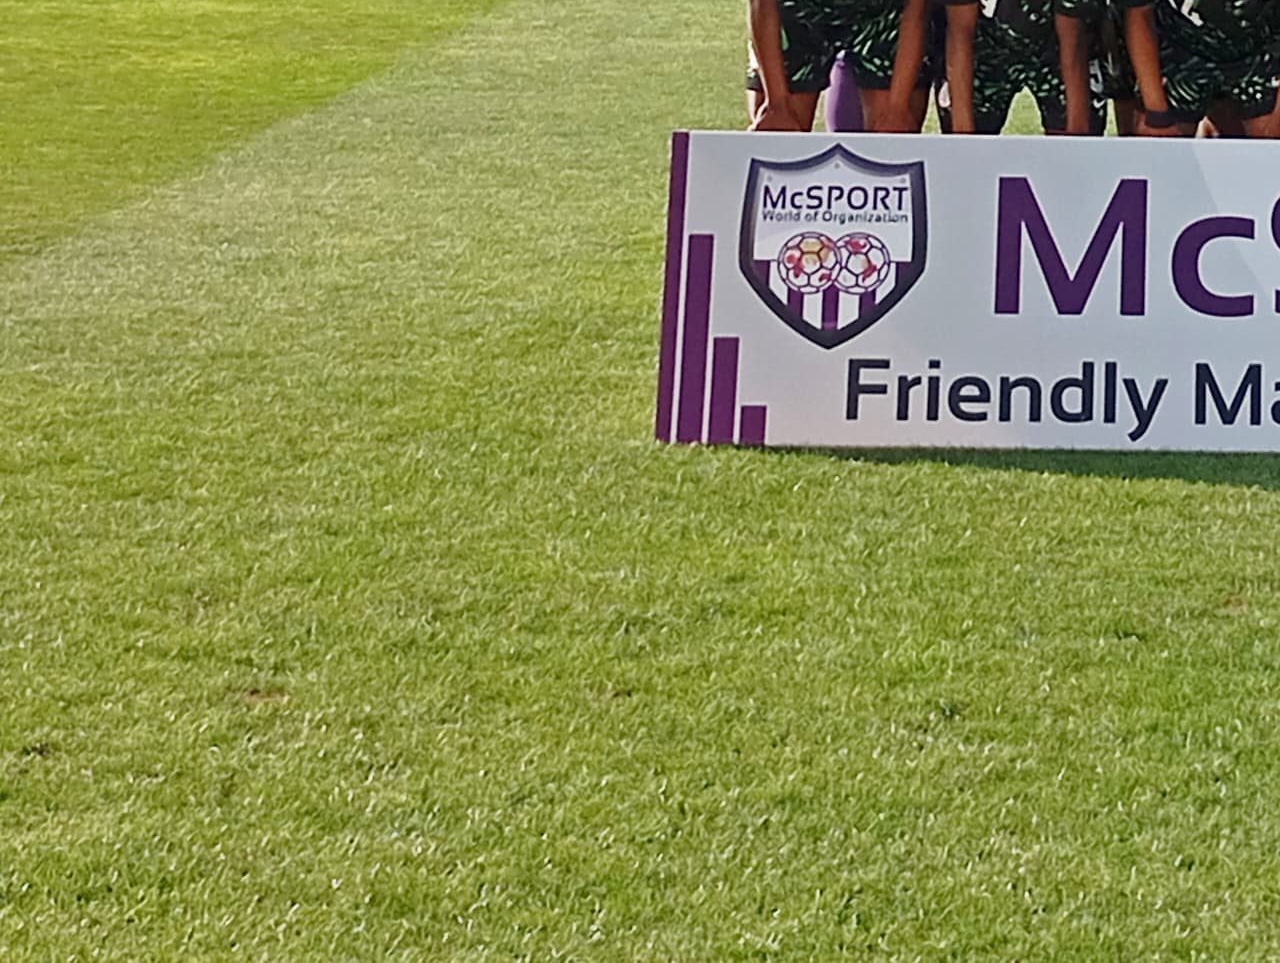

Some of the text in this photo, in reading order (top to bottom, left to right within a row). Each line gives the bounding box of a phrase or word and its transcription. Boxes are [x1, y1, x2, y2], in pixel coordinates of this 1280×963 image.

[763, 185, 909, 211] McSPORT
[763, 210, 909, 225] World of Organization
[845, 358, 1168, 442] Friendly
